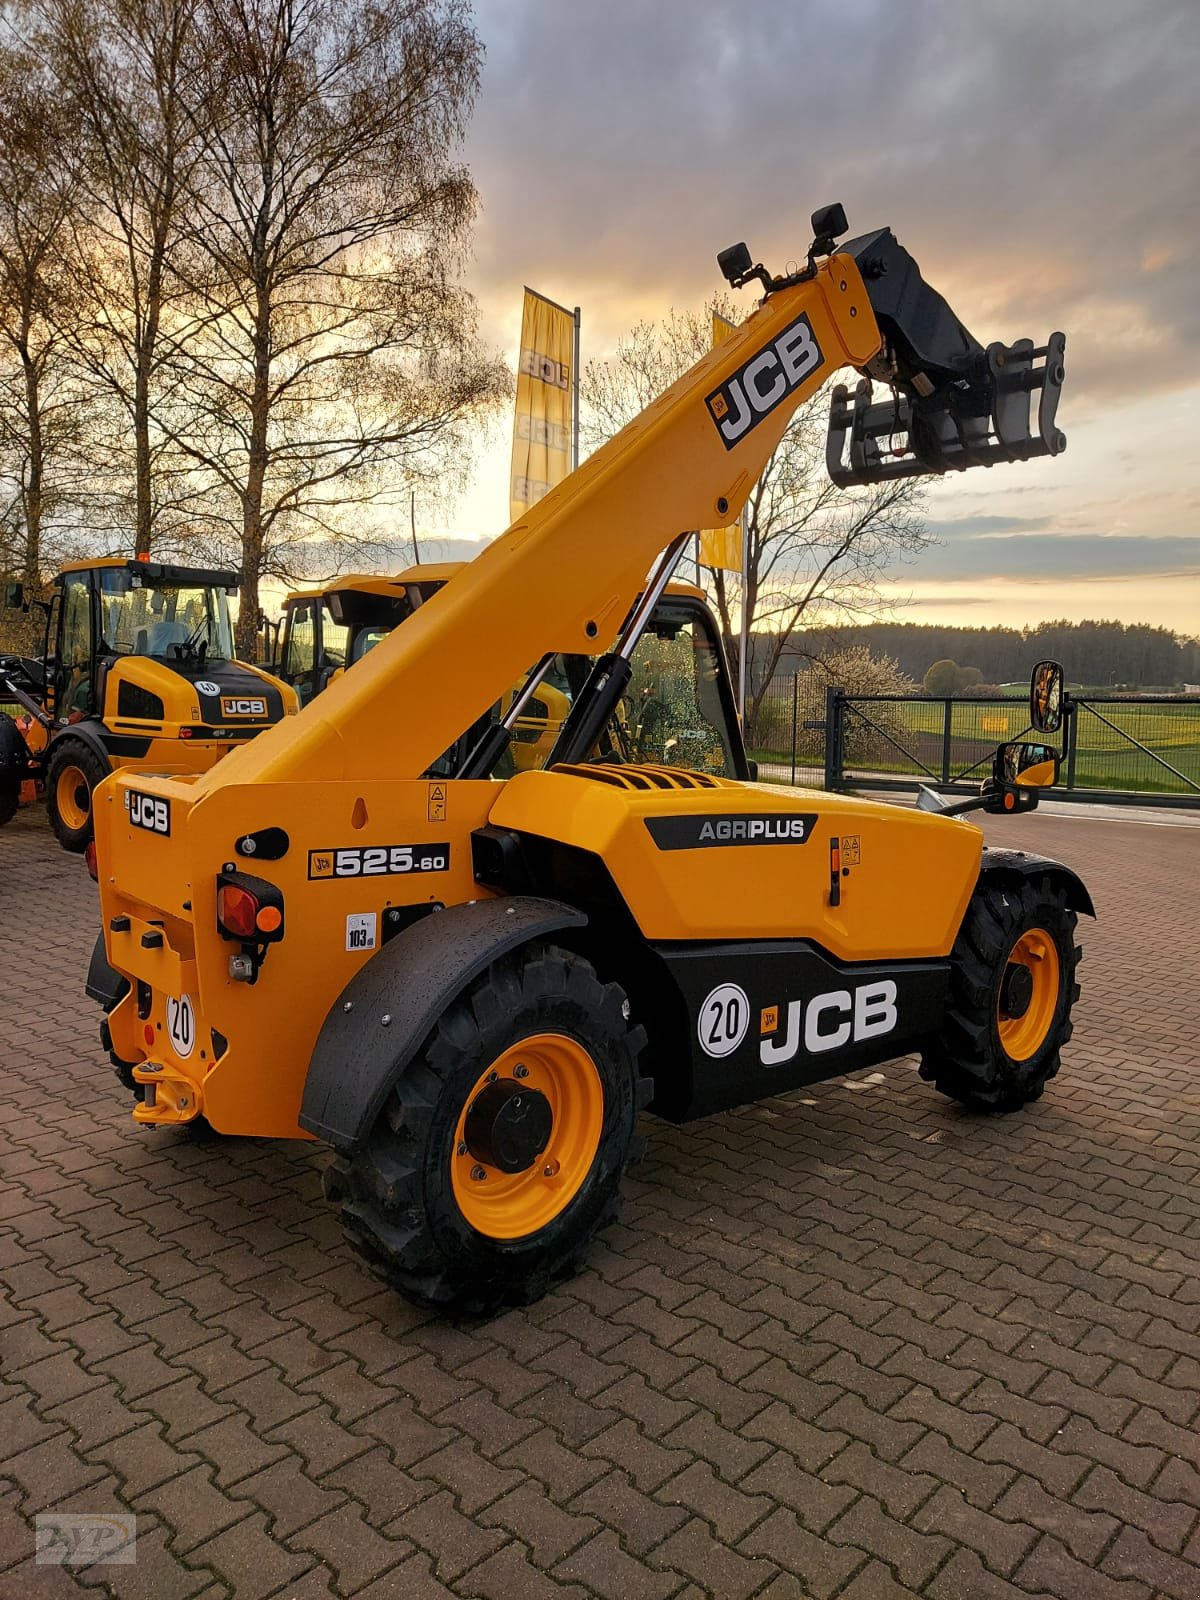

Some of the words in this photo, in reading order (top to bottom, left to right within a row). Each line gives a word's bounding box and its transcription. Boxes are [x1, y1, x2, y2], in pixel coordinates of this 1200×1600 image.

[721, 322, 819, 440] JCB
[225, 700, 264, 713] JCB
[131, 795, 168, 832] JCB
[698, 819, 805, 841] AGRIPLUS
[349, 929, 367, 948] 103
[172, 998, 190, 1045] 20
[708, 997, 740, 1045] 20
[760, 979, 898, 1065] JCB
